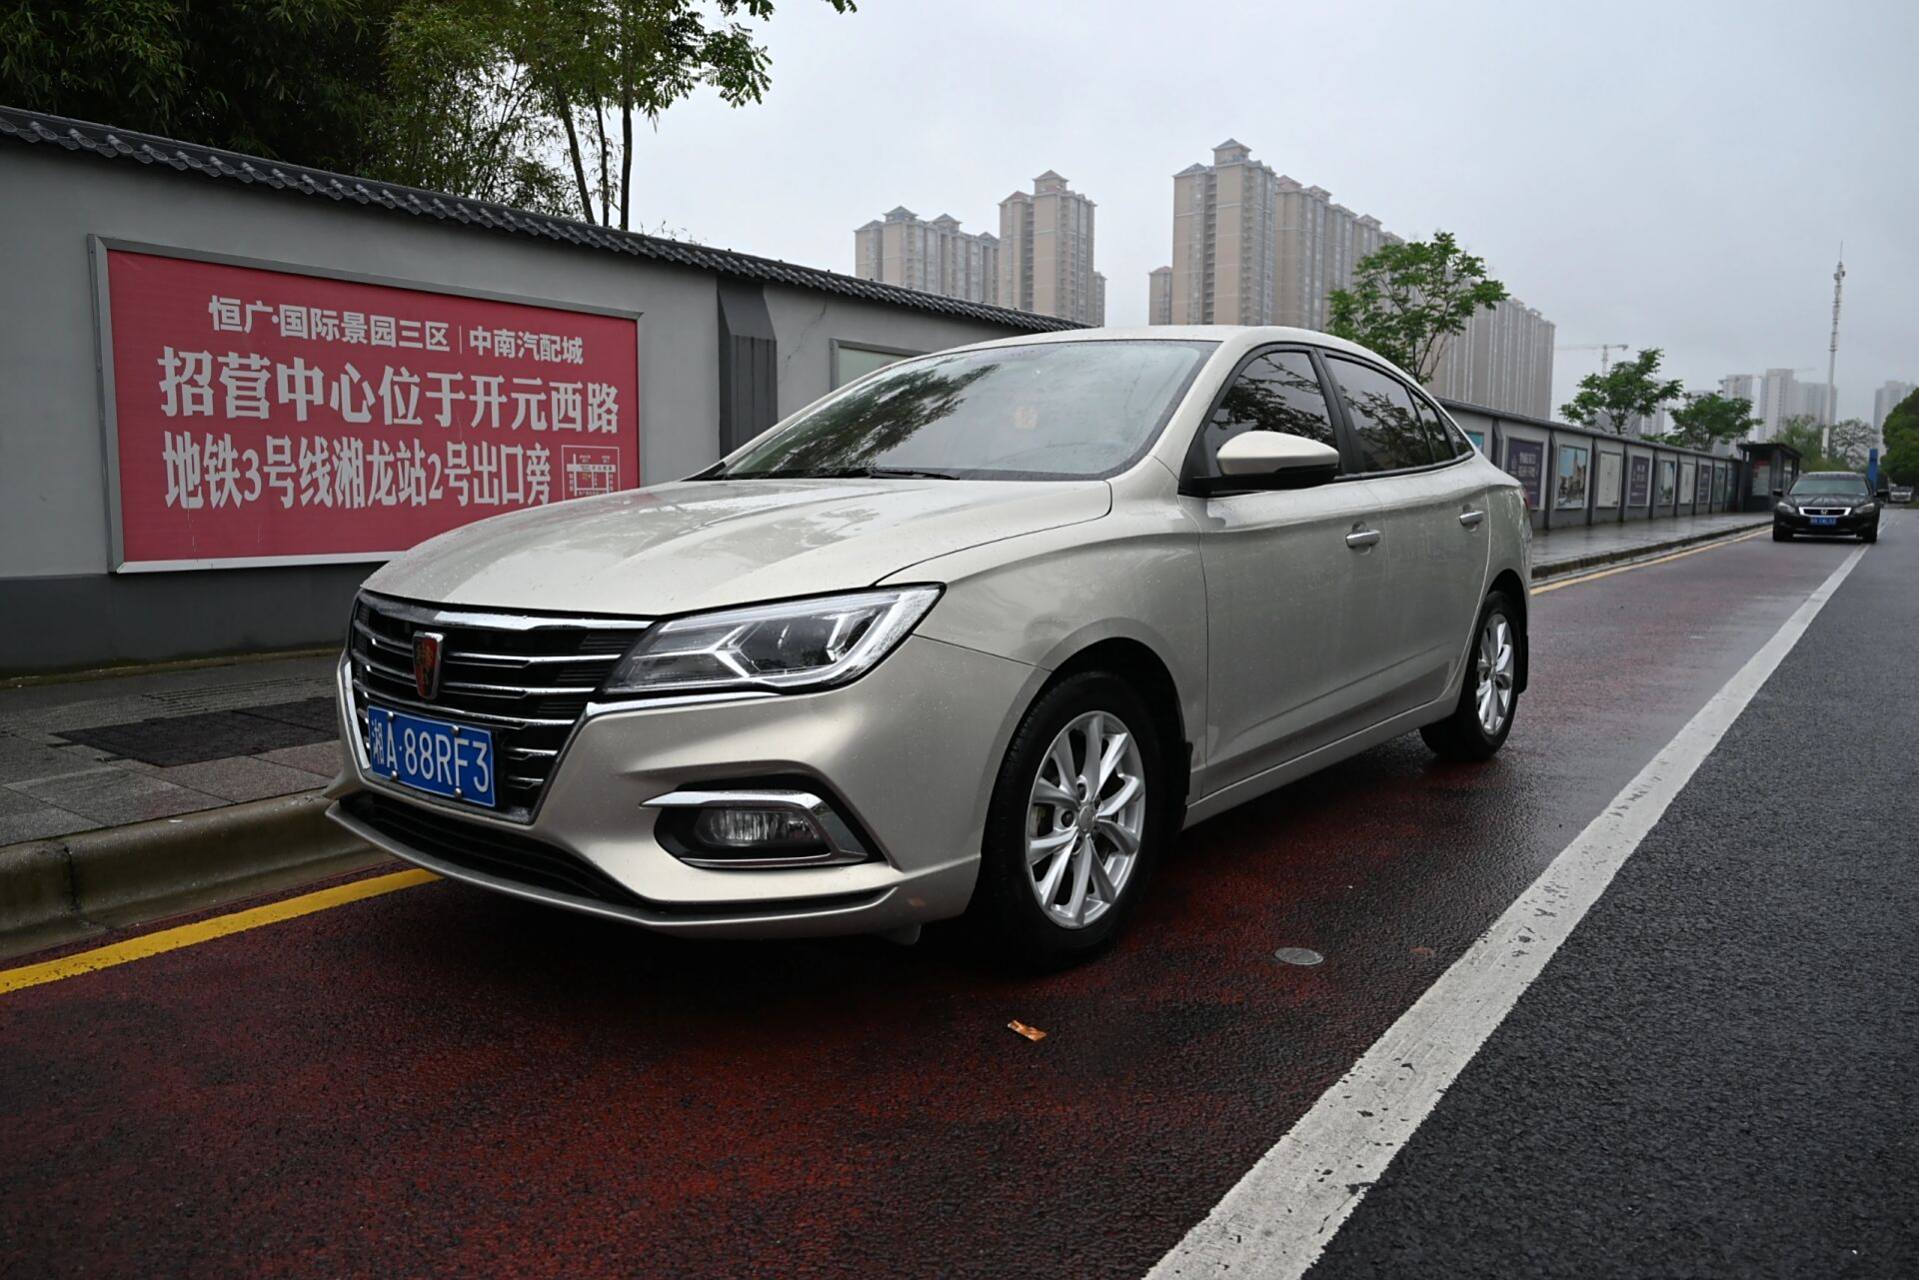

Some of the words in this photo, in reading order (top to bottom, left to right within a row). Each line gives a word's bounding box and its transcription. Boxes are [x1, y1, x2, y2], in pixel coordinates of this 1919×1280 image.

[469, 326, 584, 365] 中南汽配城
[157, 346, 620, 434] 招营中心位于开元西路
[162, 431, 550, 509] 地铁3号线湘龙站2号出口旁
